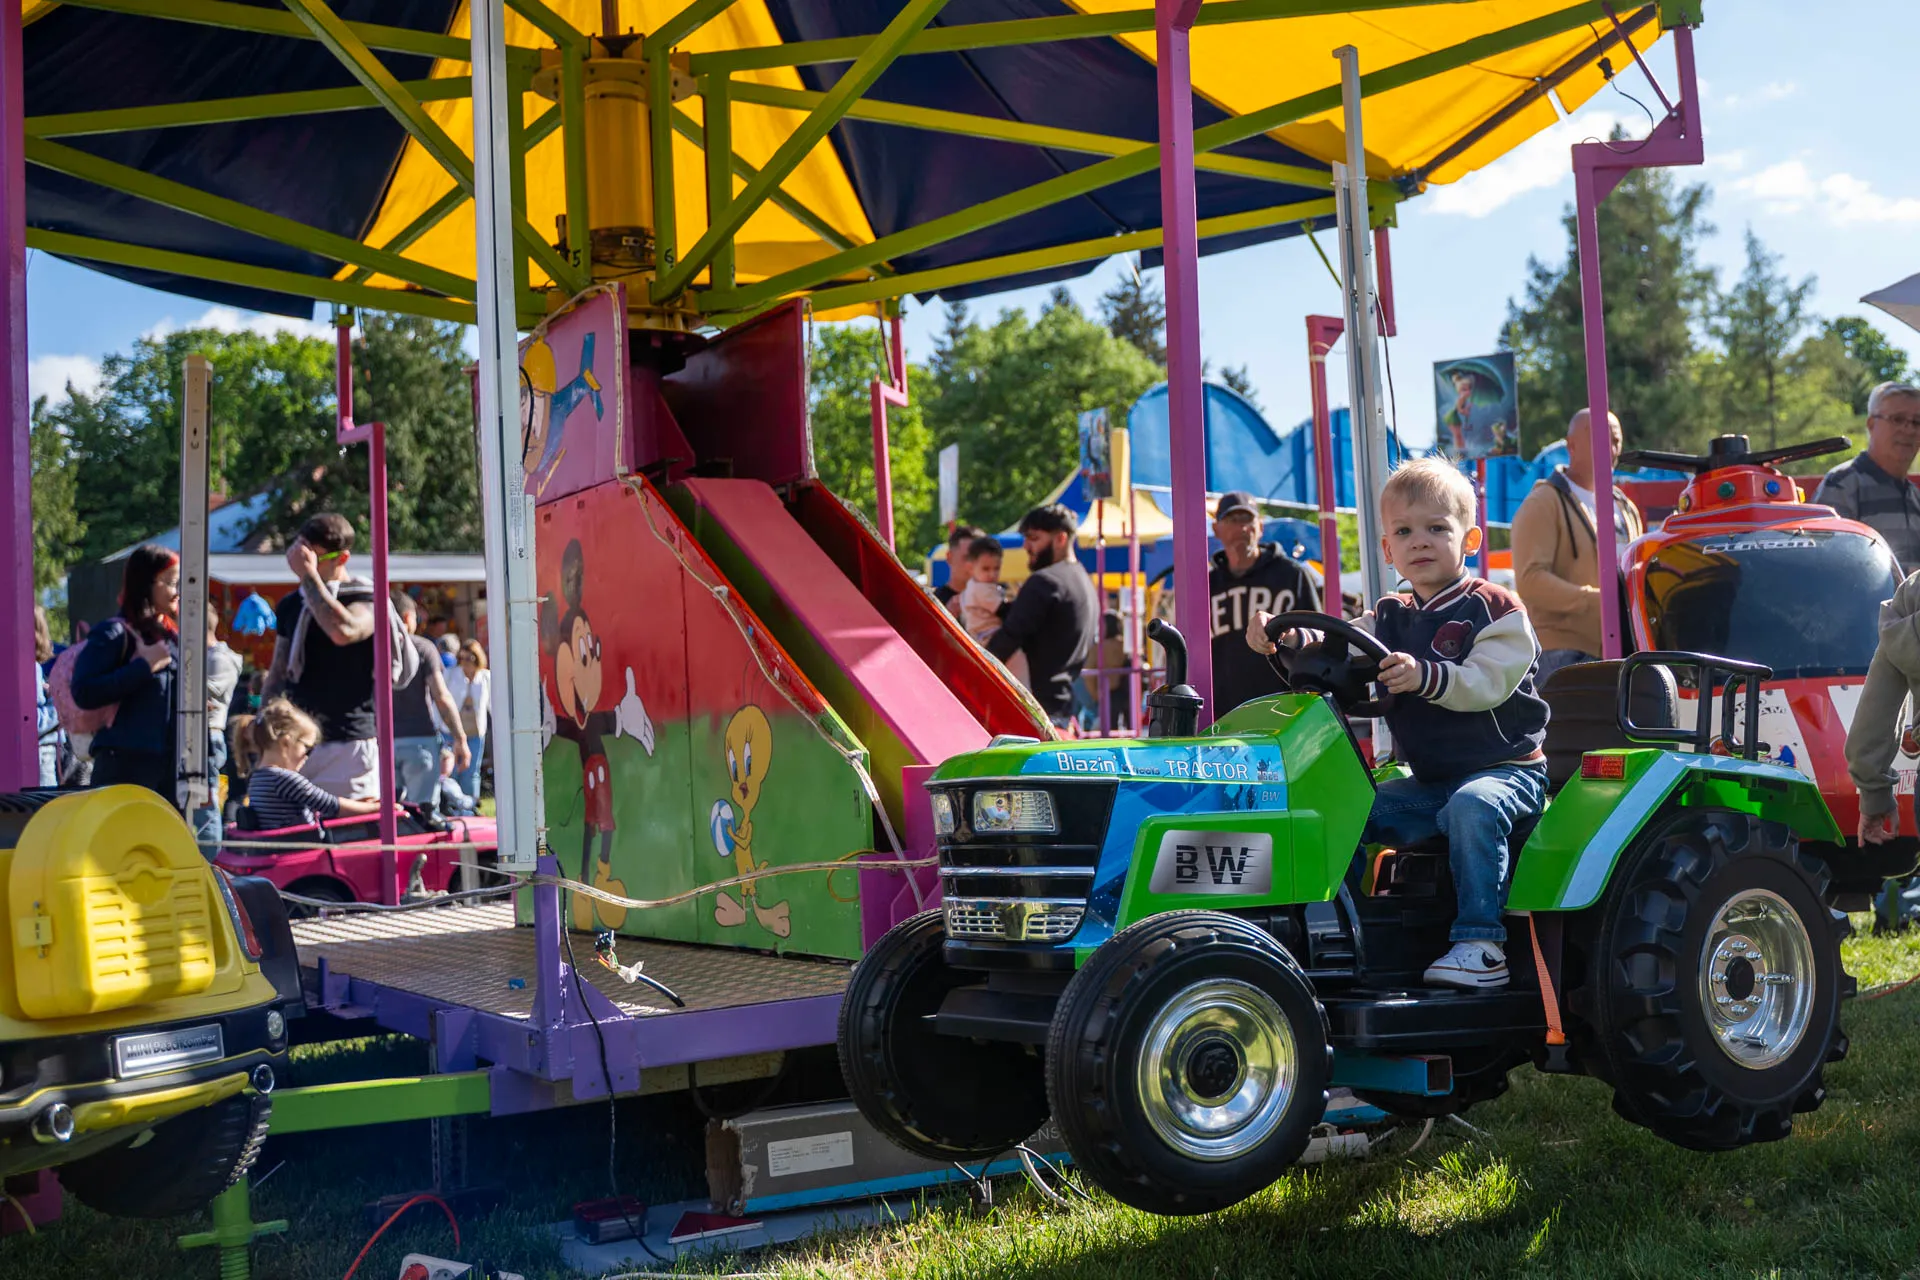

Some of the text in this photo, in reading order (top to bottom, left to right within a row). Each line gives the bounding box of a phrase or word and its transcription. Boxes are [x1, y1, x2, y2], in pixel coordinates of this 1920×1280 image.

[1056, 751, 1118, 773] Blazin'
[1164, 759, 1249, 780] TRACTOR
[1261, 790, 1281, 802] BW
[1175, 844, 1250, 885] BW
[126, 1042, 152, 1058] MINI
